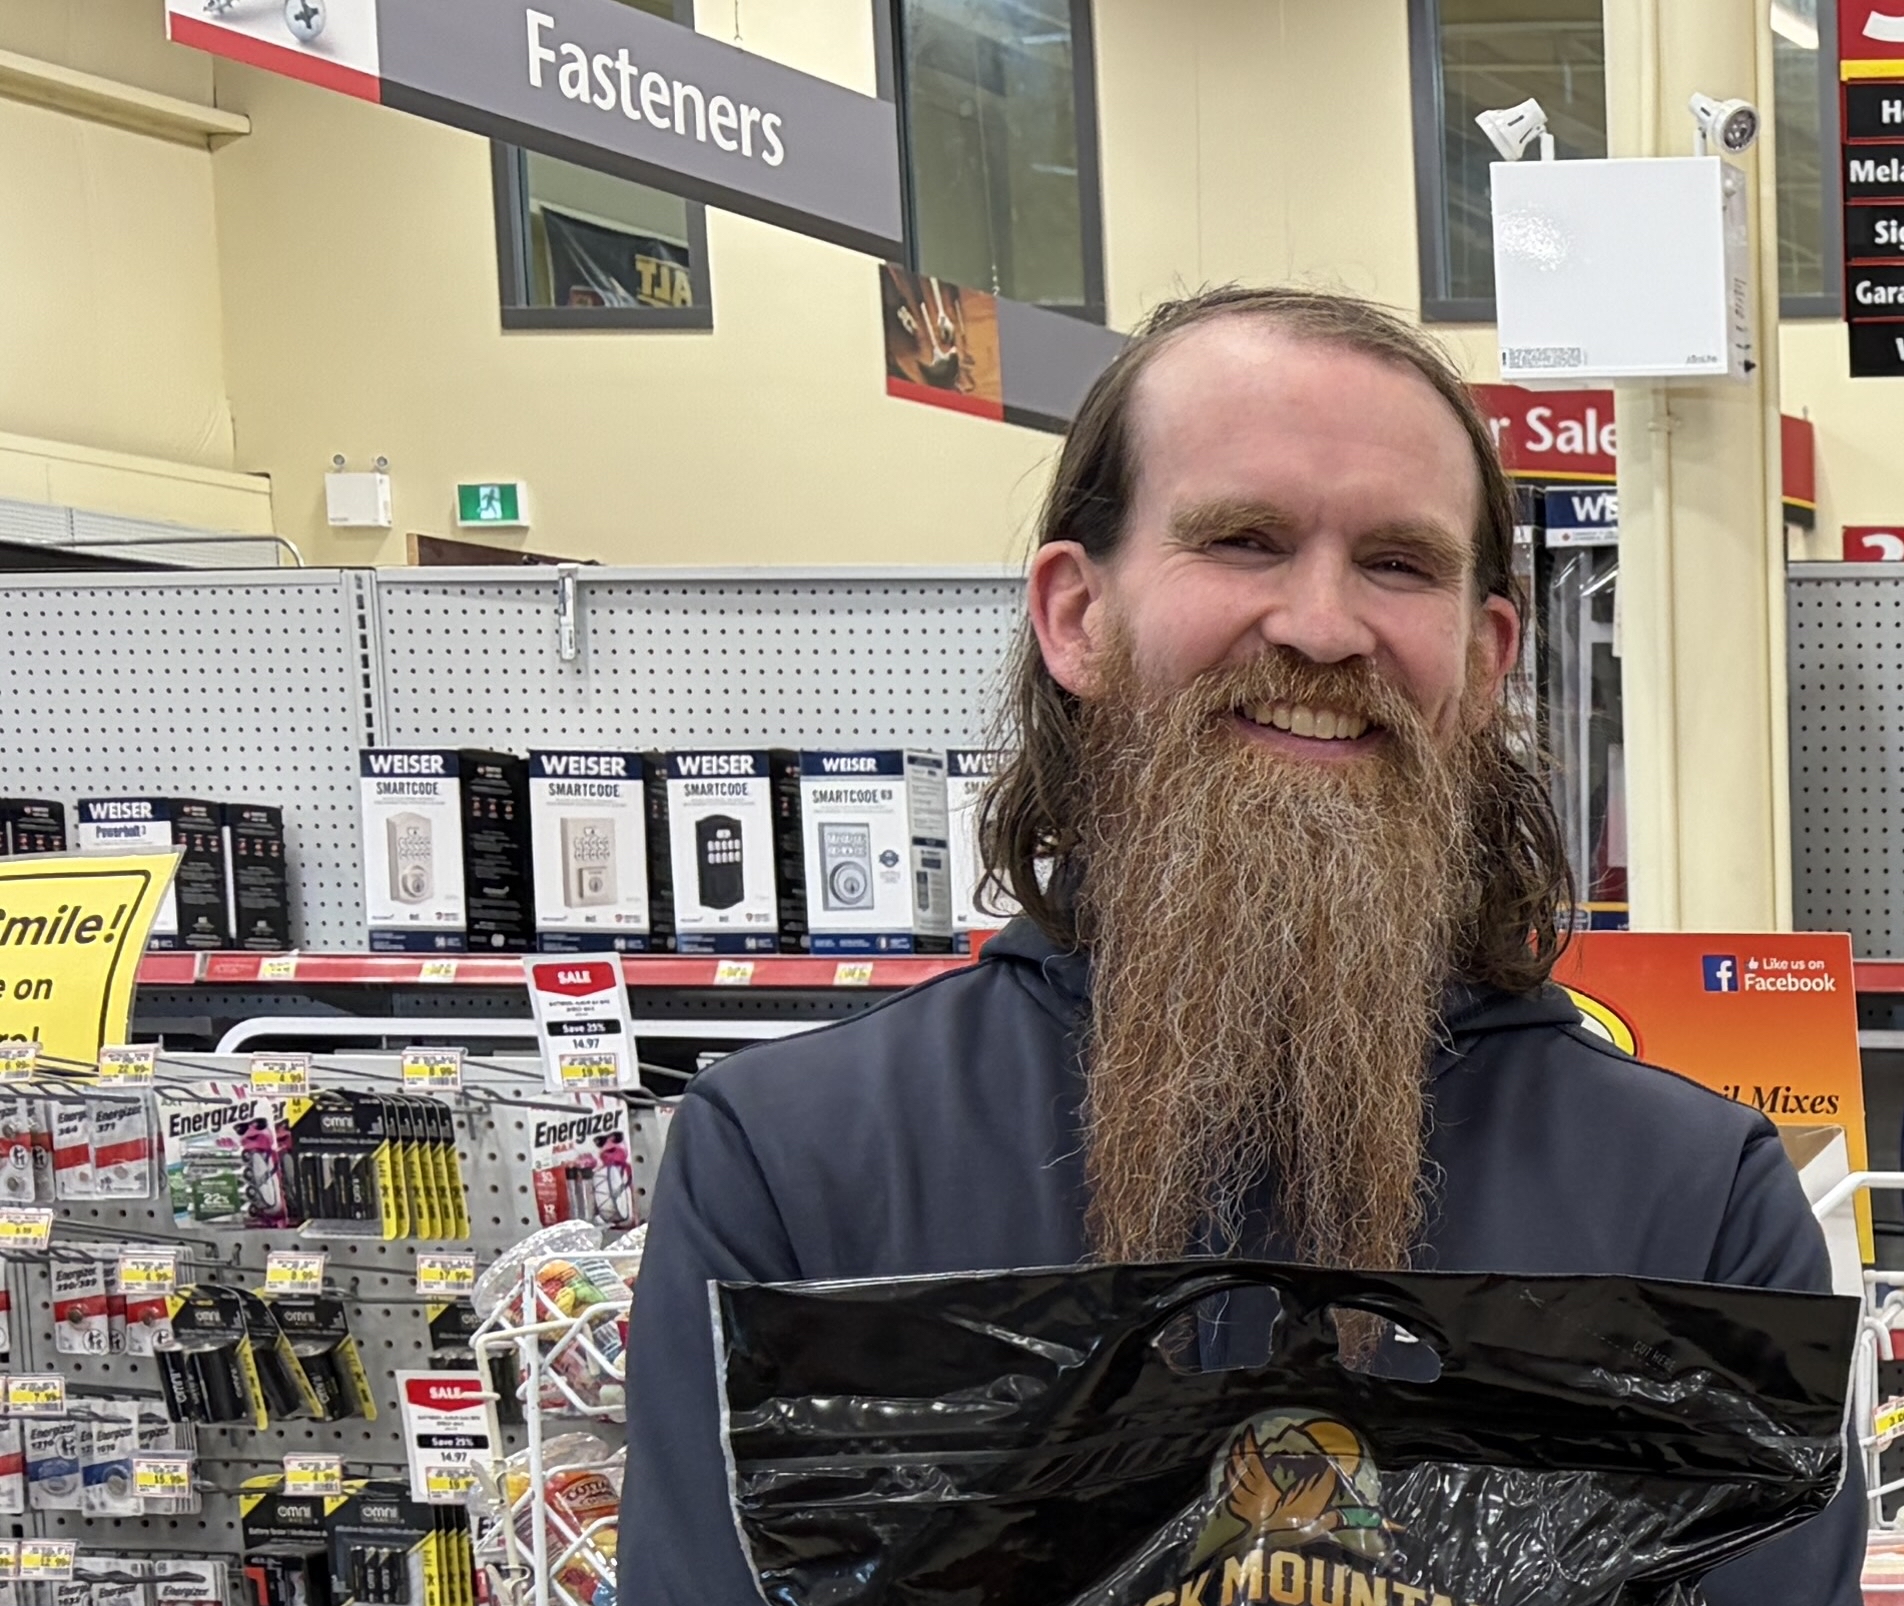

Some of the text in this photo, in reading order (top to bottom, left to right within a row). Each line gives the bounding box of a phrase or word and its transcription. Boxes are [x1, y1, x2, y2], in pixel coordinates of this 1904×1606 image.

[525, 8, 785, 167] Fasteners
[369, 755, 446, 774] WEISER
[541, 755, 627, 776] WEISER
[677, 755, 756, 776] WEISER
[822, 756, 877, 773] WEISER
[376, 781, 439, 796] SMARTCODE
[548, 782, 620, 798] SMARTCODE
[684, 782, 748, 798] SMARTCODE
[812, 790, 877, 803] SMARTCODE
[88, 802, 152, 820] WEISER
[0, 903, 127, 946] mile!
[1762, 957, 1824, 970] Like us on
[558, 970, 592, 985] SALE
[1744, 973, 1836, 993] Facebook
[14, 978, 53, 1000] on
[1751, 1086, 1839, 1115] Mixes
[169, 1100, 258, 1137] Energizer
[535, 1108, 624, 1148] Energizer
